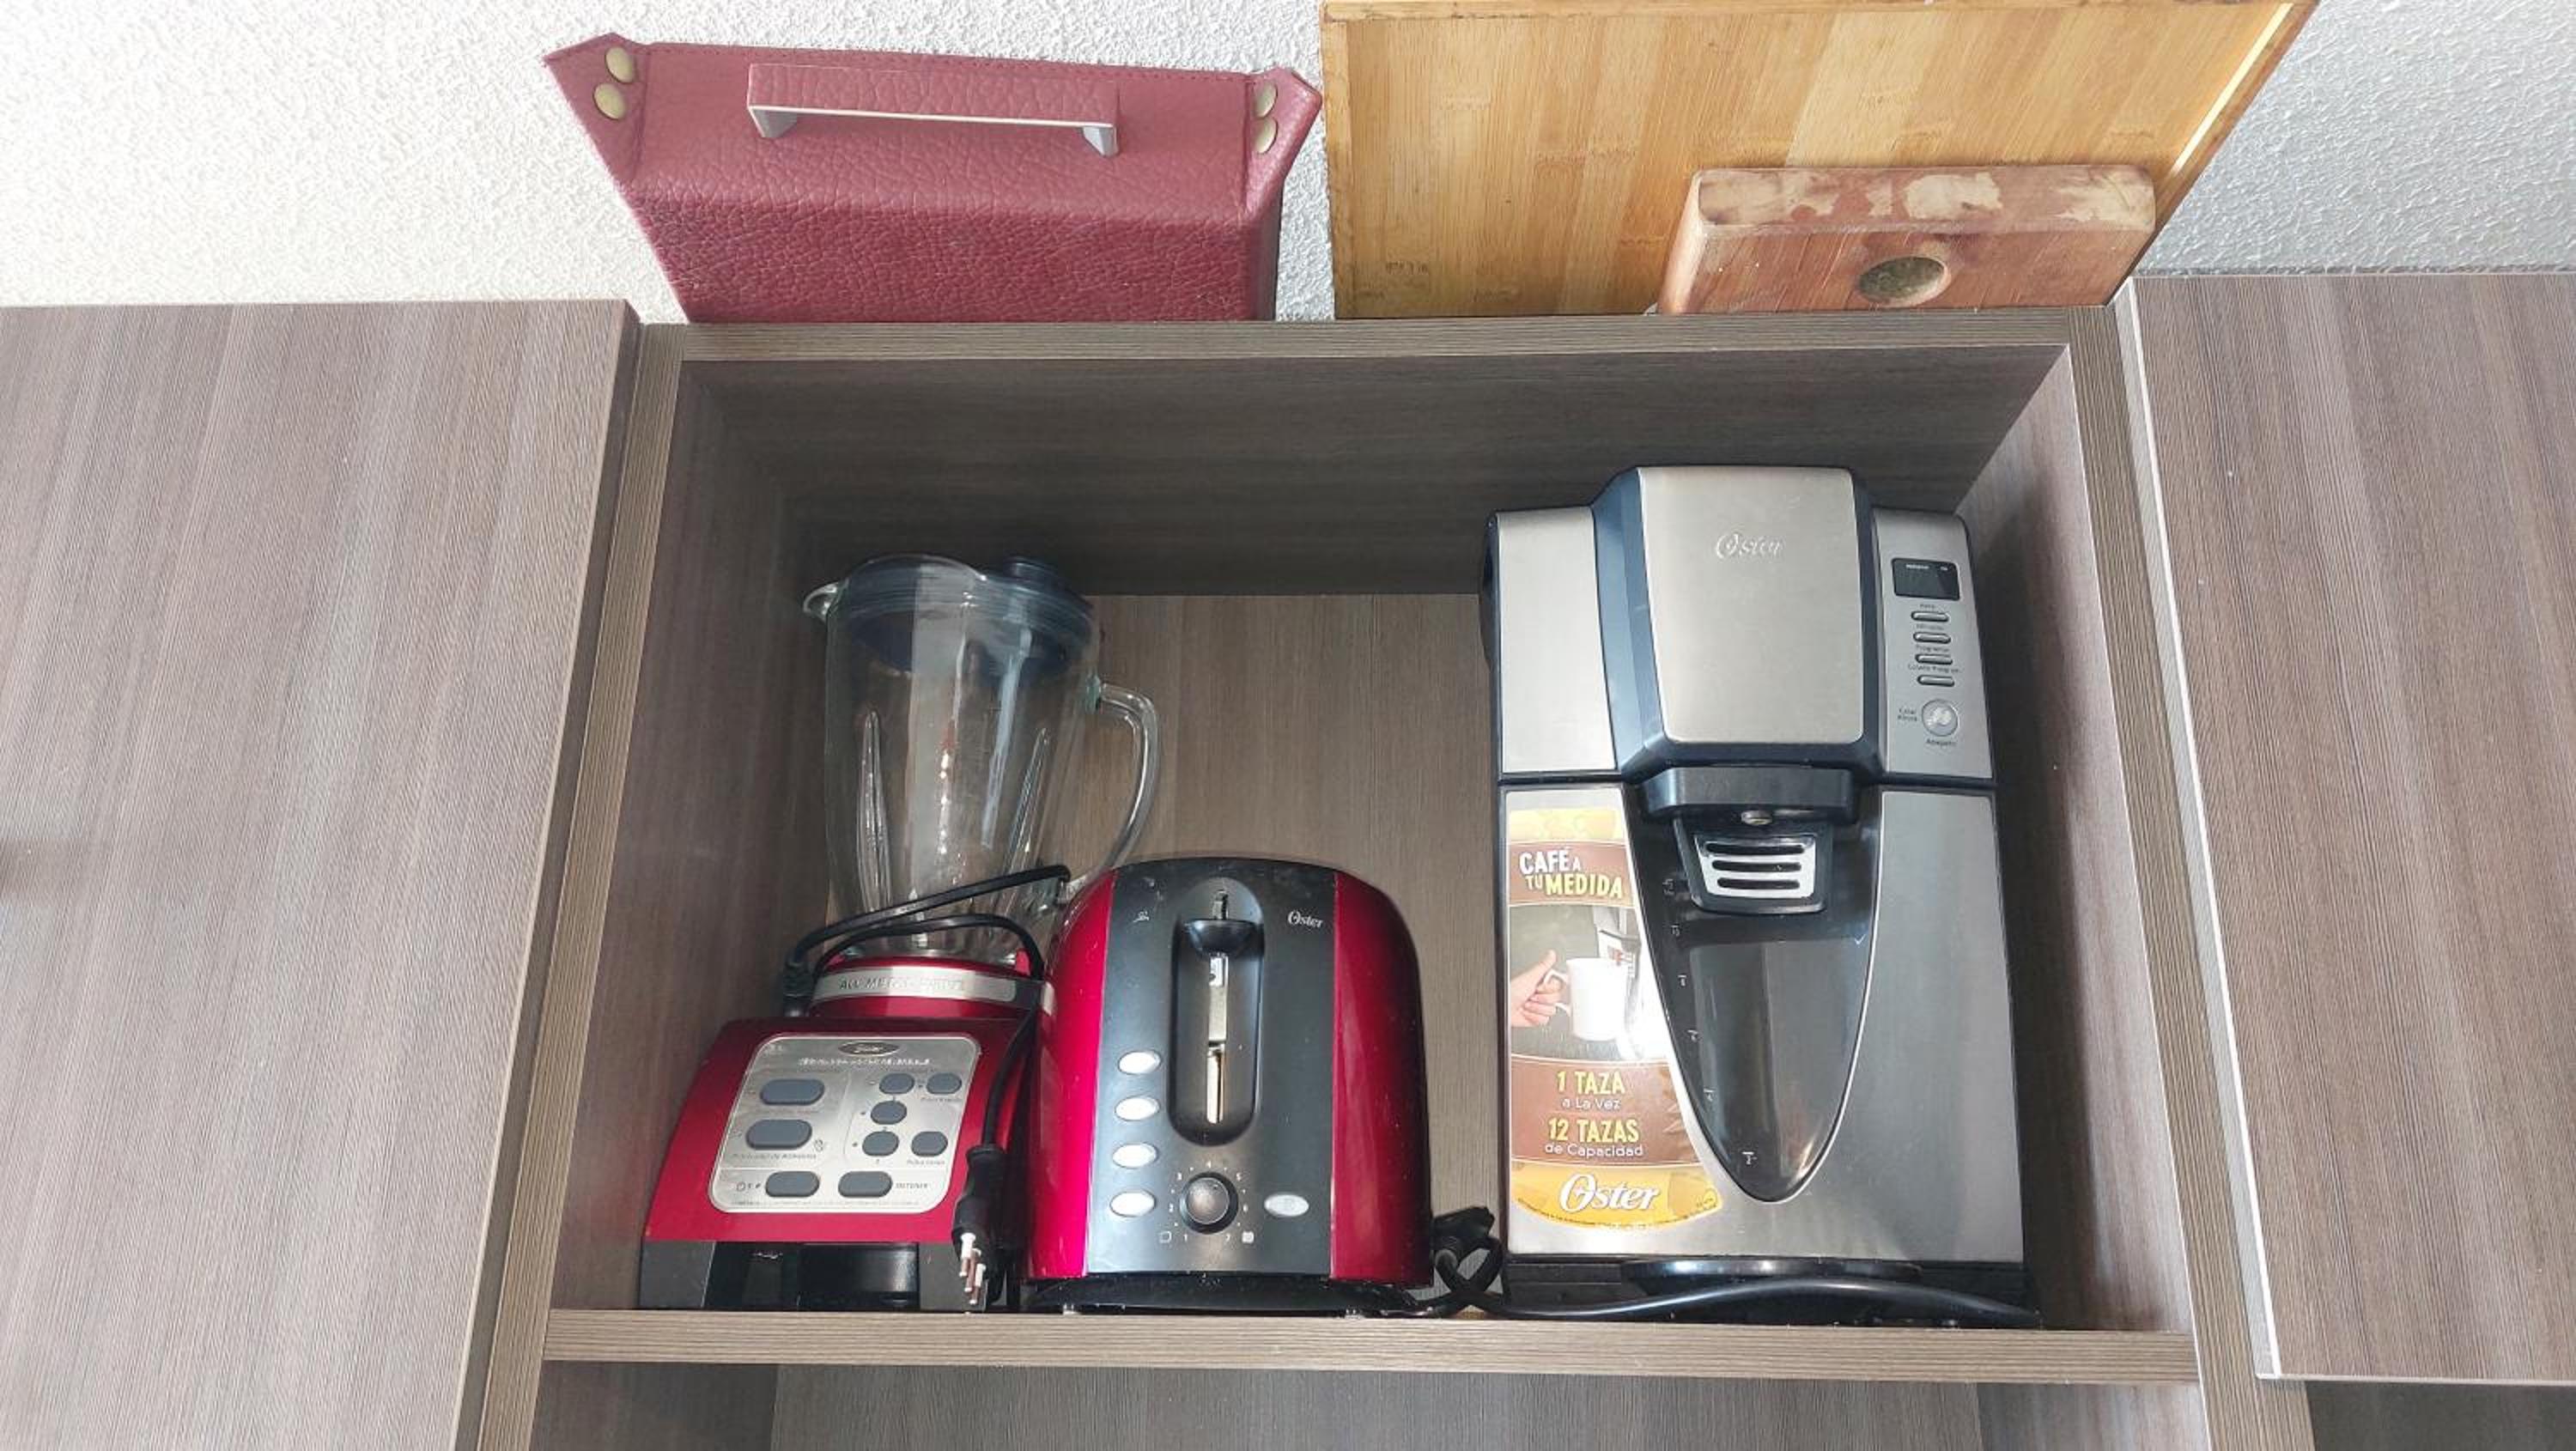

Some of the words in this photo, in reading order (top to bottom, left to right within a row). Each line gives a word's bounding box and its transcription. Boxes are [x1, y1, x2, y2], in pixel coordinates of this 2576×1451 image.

[1572, 856, 1582, 871] A
[1525, 875, 1543, 890] TU
[1545, 873, 1622, 899] MEDIDA
[1288, 910, 1323, 928] Oster
[1557, 1071, 1566, 1093] 1
[1574, 1070, 1625, 1095] TAZA
[1562, 1098, 1571, 1108] a
[1575, 1097, 1591, 1109] La
[1548, 1117, 1569, 1141] 12
[1576, 1118, 1639, 1144] TAZAS
[1545, 1141, 1563, 1154] de
[1566, 1143, 1643, 1158] Capacidad
[1559, 1173, 1662, 1214] Oster
